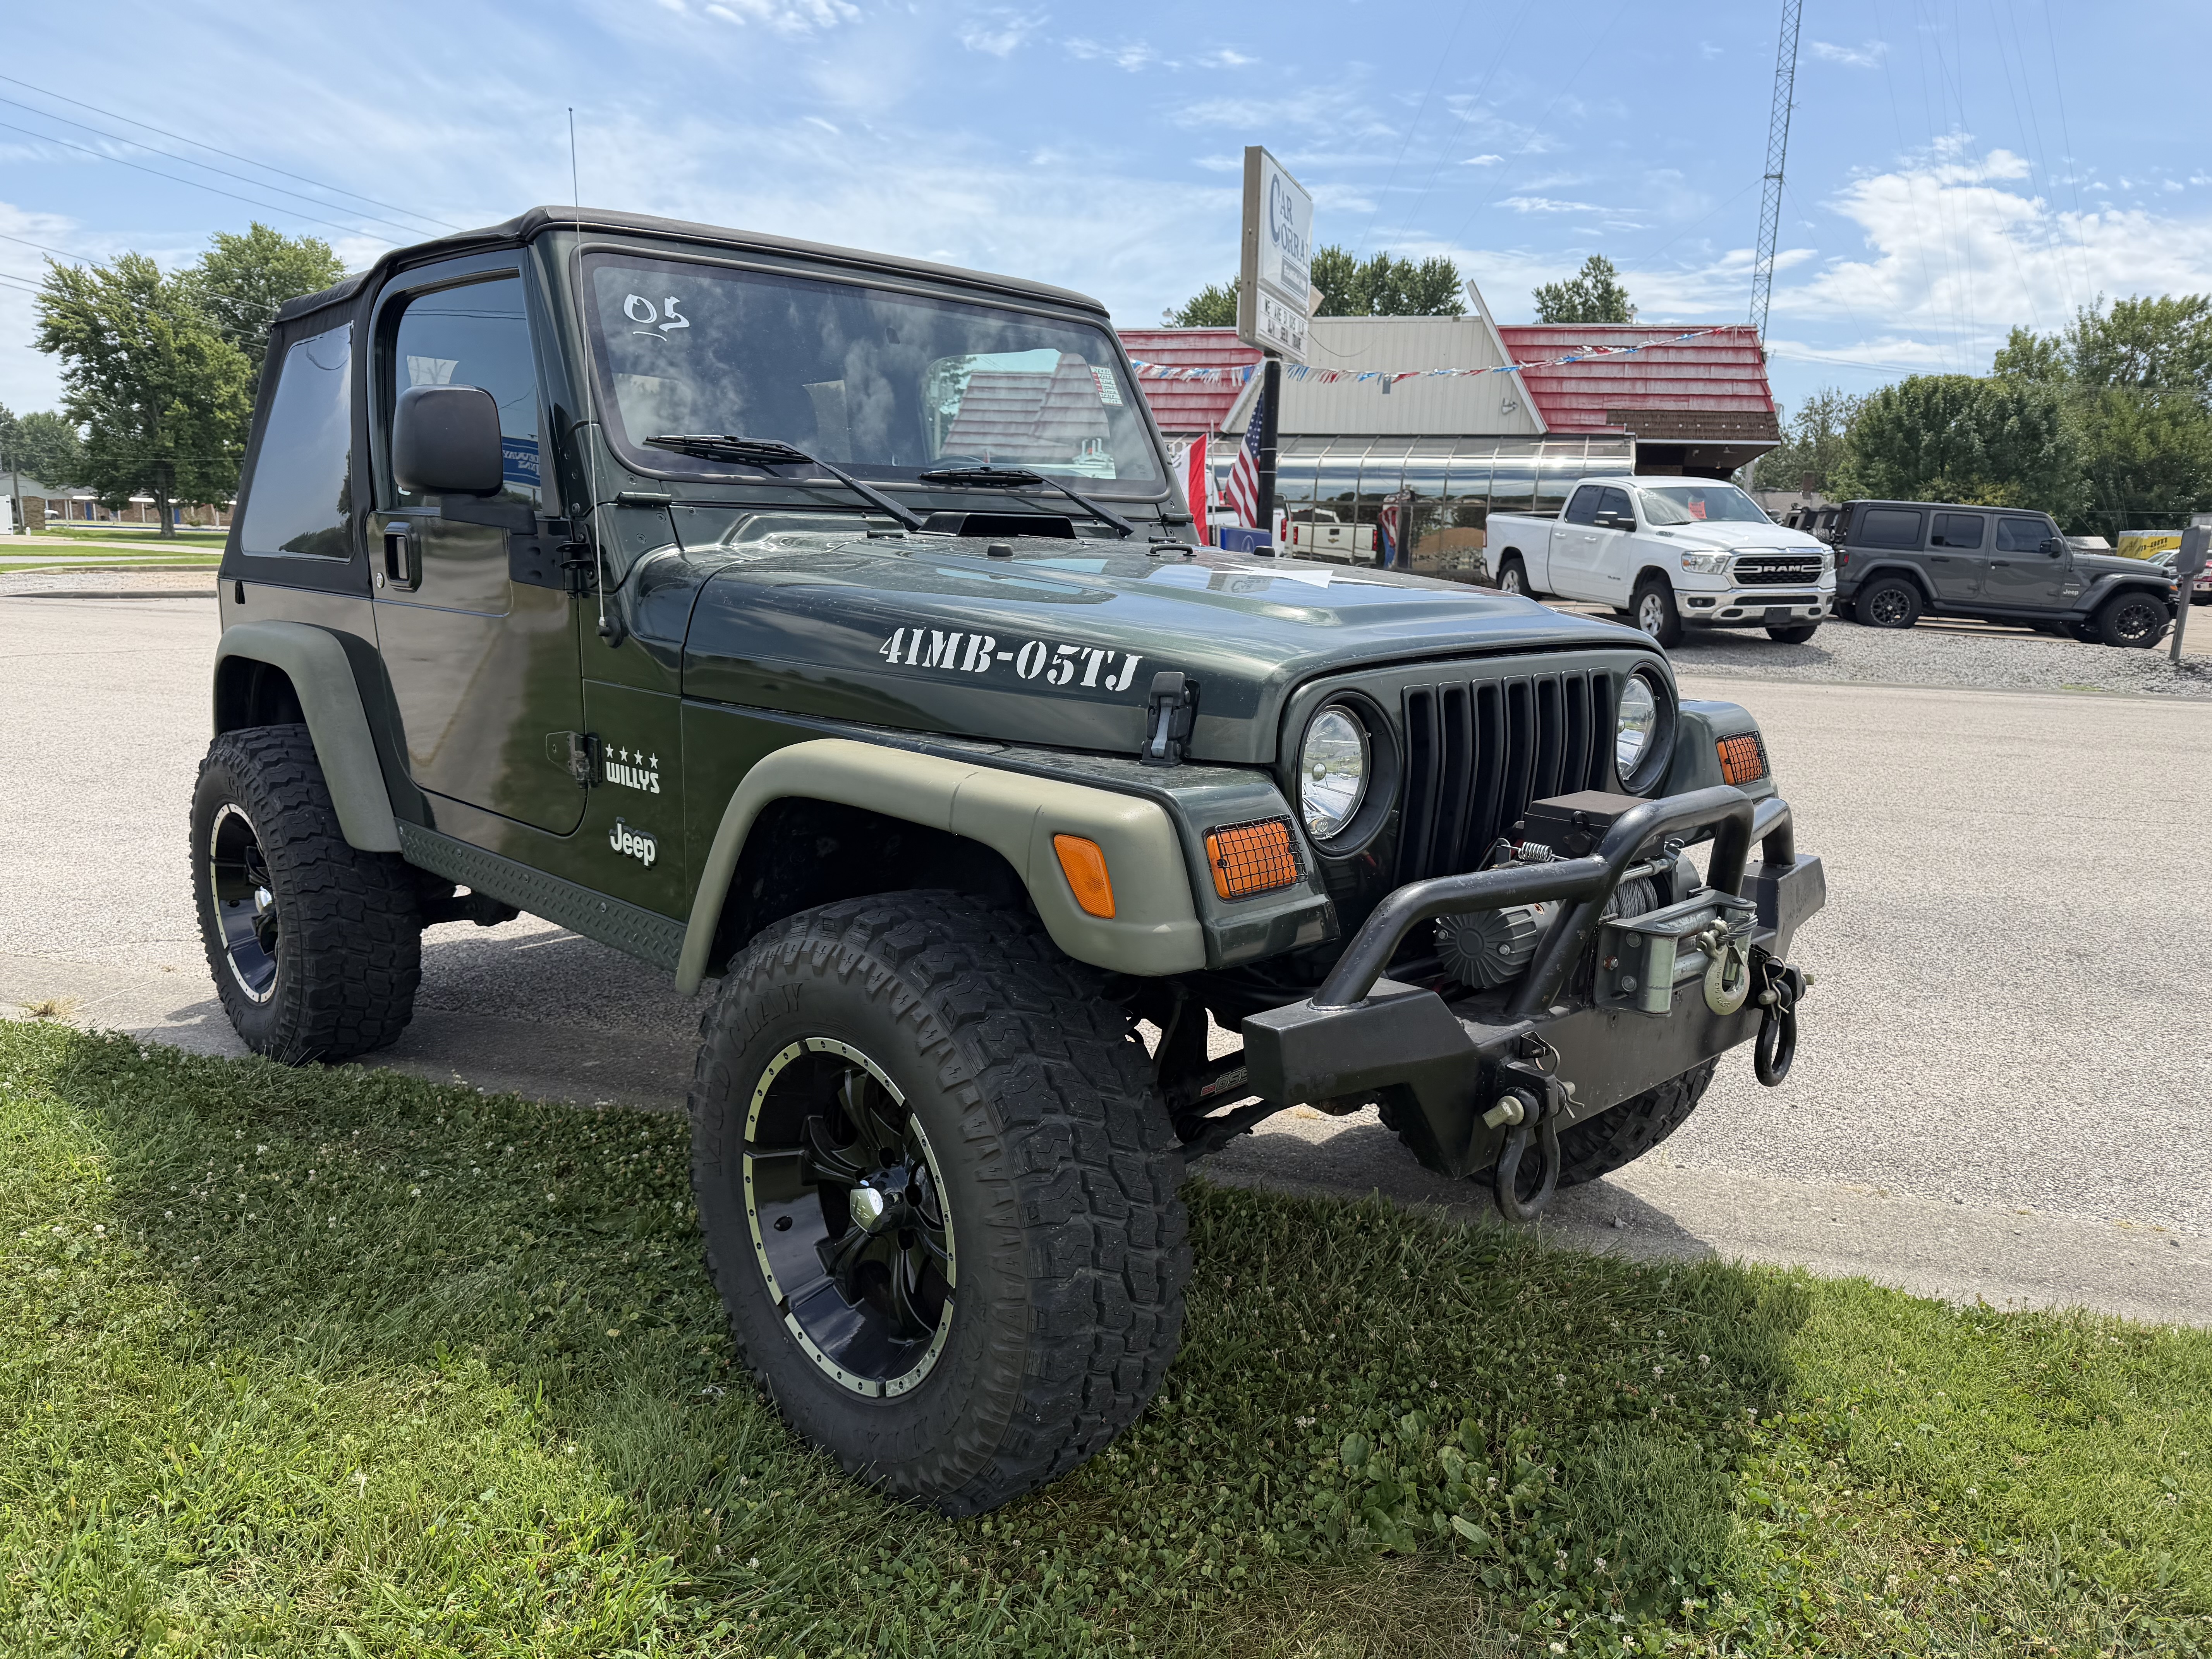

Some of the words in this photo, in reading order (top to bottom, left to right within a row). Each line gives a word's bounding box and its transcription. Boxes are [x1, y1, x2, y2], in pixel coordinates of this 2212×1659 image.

[1270, 173, 1293, 243] CAR
[624, 294, 689, 332] 05
[879, 627, 1143, 691] 41MB-05TJ
[606, 761, 660, 793] WILLYS
[610, 823, 656, 866] Jeep
